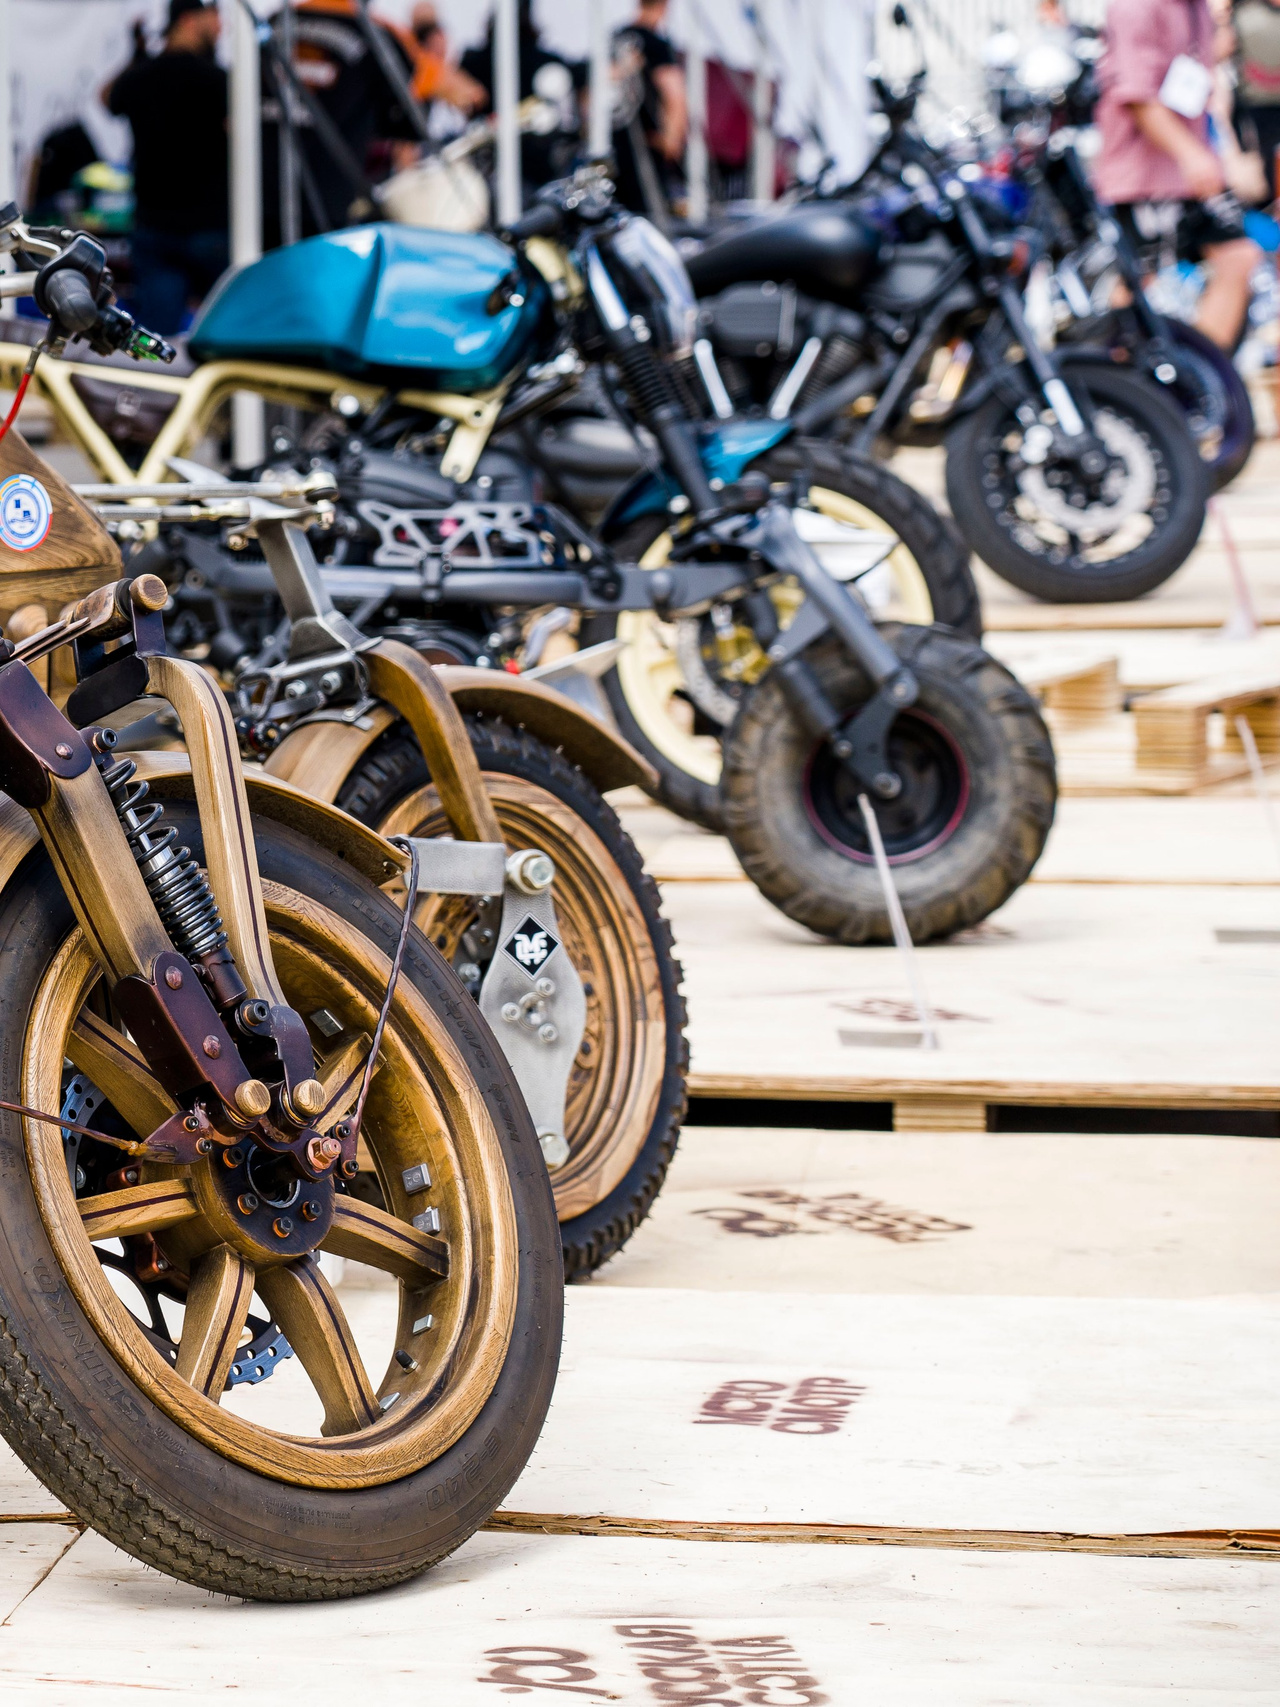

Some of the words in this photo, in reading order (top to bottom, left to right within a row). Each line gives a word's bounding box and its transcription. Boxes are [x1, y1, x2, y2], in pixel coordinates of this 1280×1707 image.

[32, 1264, 147, 1423] SHINKO
[692, 1379, 788, 1427] МОТО
[769, 1376, 868, 1435] СМОТР
[426, 1426, 502, 1511] E-240
